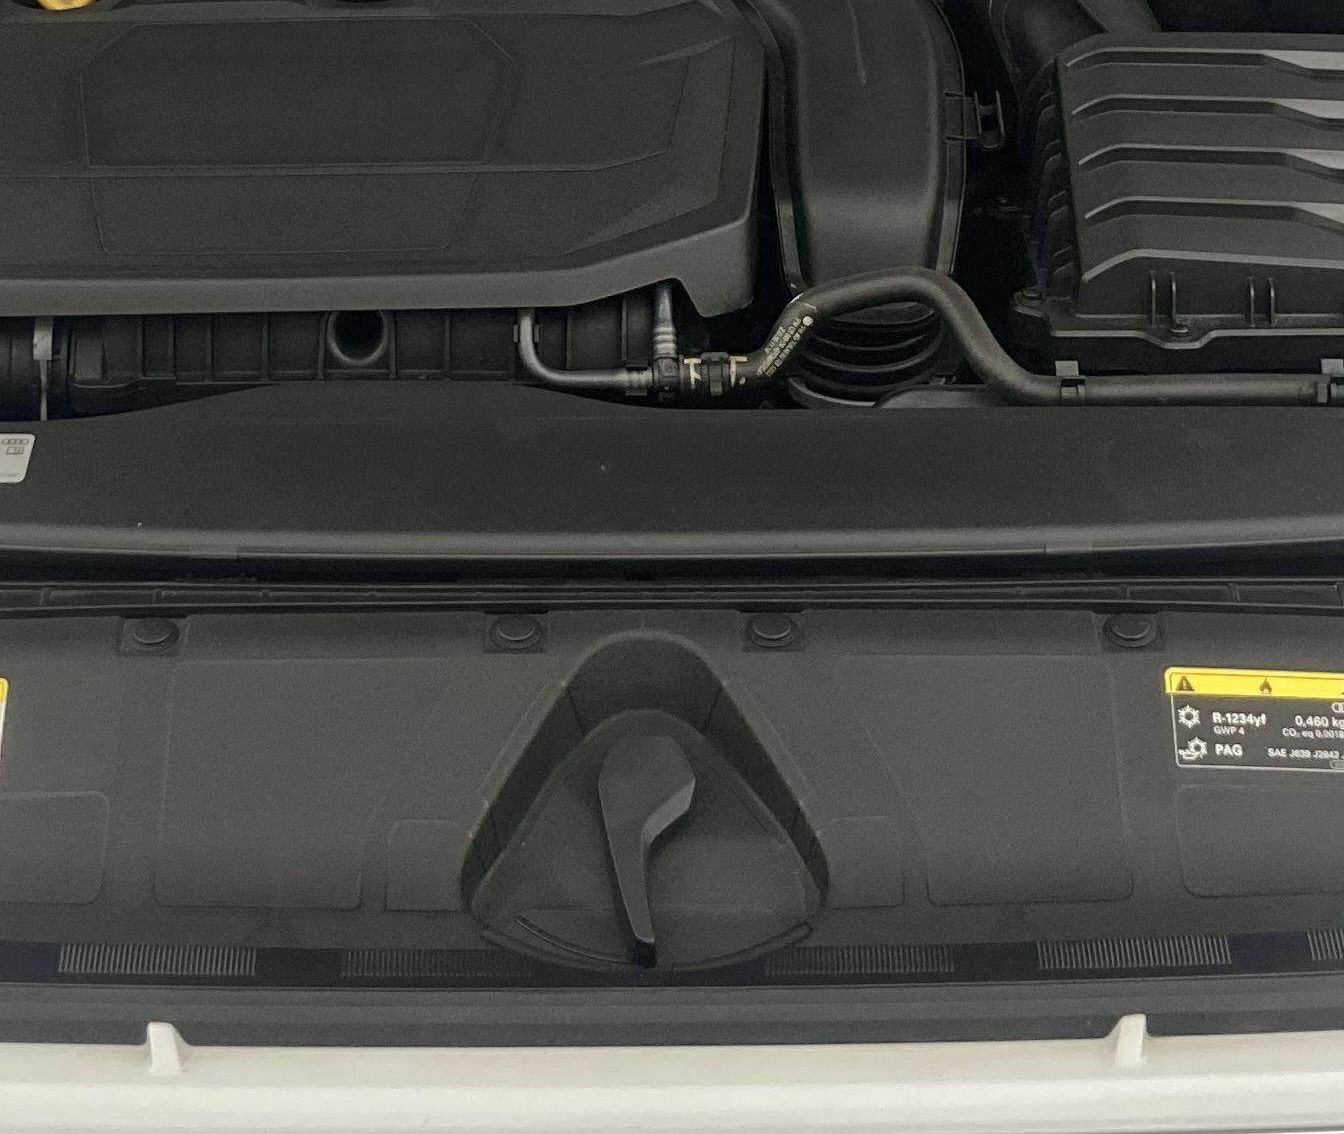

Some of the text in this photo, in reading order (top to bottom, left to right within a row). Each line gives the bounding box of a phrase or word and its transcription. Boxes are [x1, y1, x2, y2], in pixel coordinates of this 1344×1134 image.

[1212, 712, 1266, 727] R-1234yf
[1213, 726, 1236, 734] GWP
[1301, 730, 1314, 738] eq
[1215, 744, 1243, 756] PAG
[1267, 748, 1287, 757] SAE
